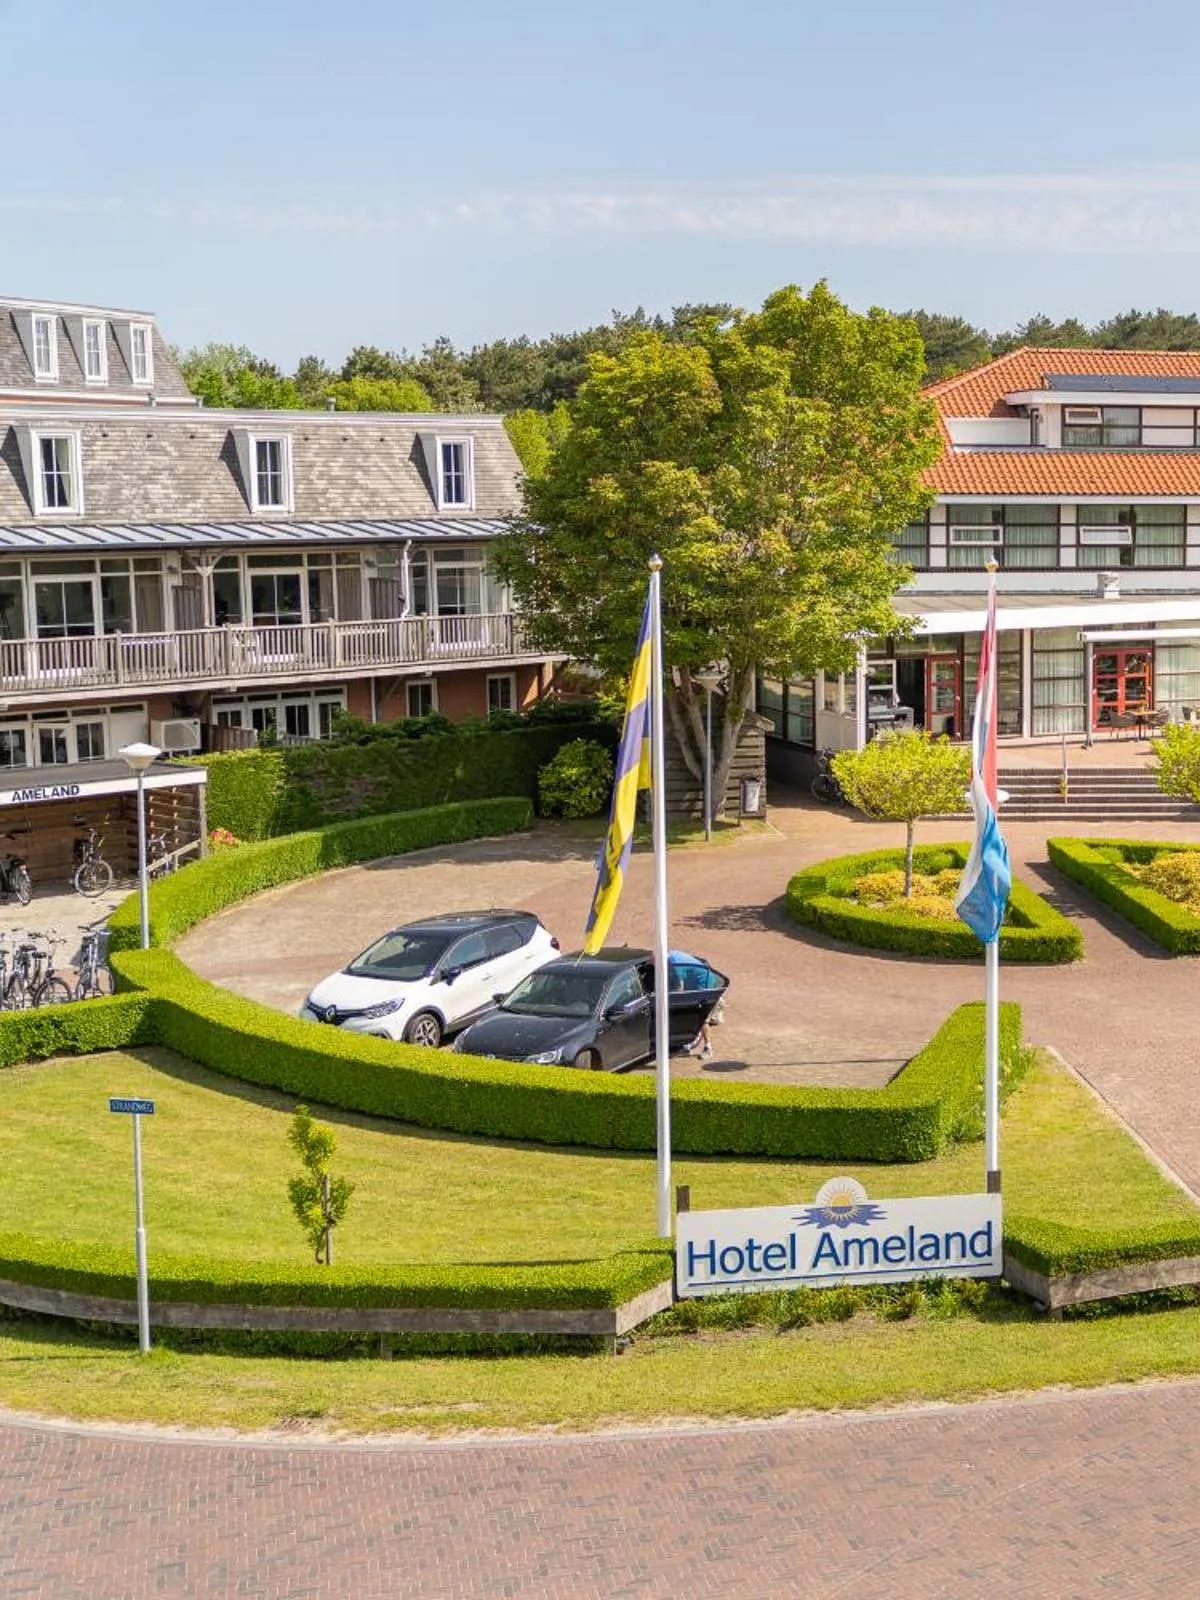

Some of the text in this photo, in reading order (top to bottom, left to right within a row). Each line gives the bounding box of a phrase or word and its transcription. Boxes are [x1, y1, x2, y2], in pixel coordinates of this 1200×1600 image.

[12, 785, 80, 801] AMELAND
[688, 1220, 993, 1277] Hotel Ameland
